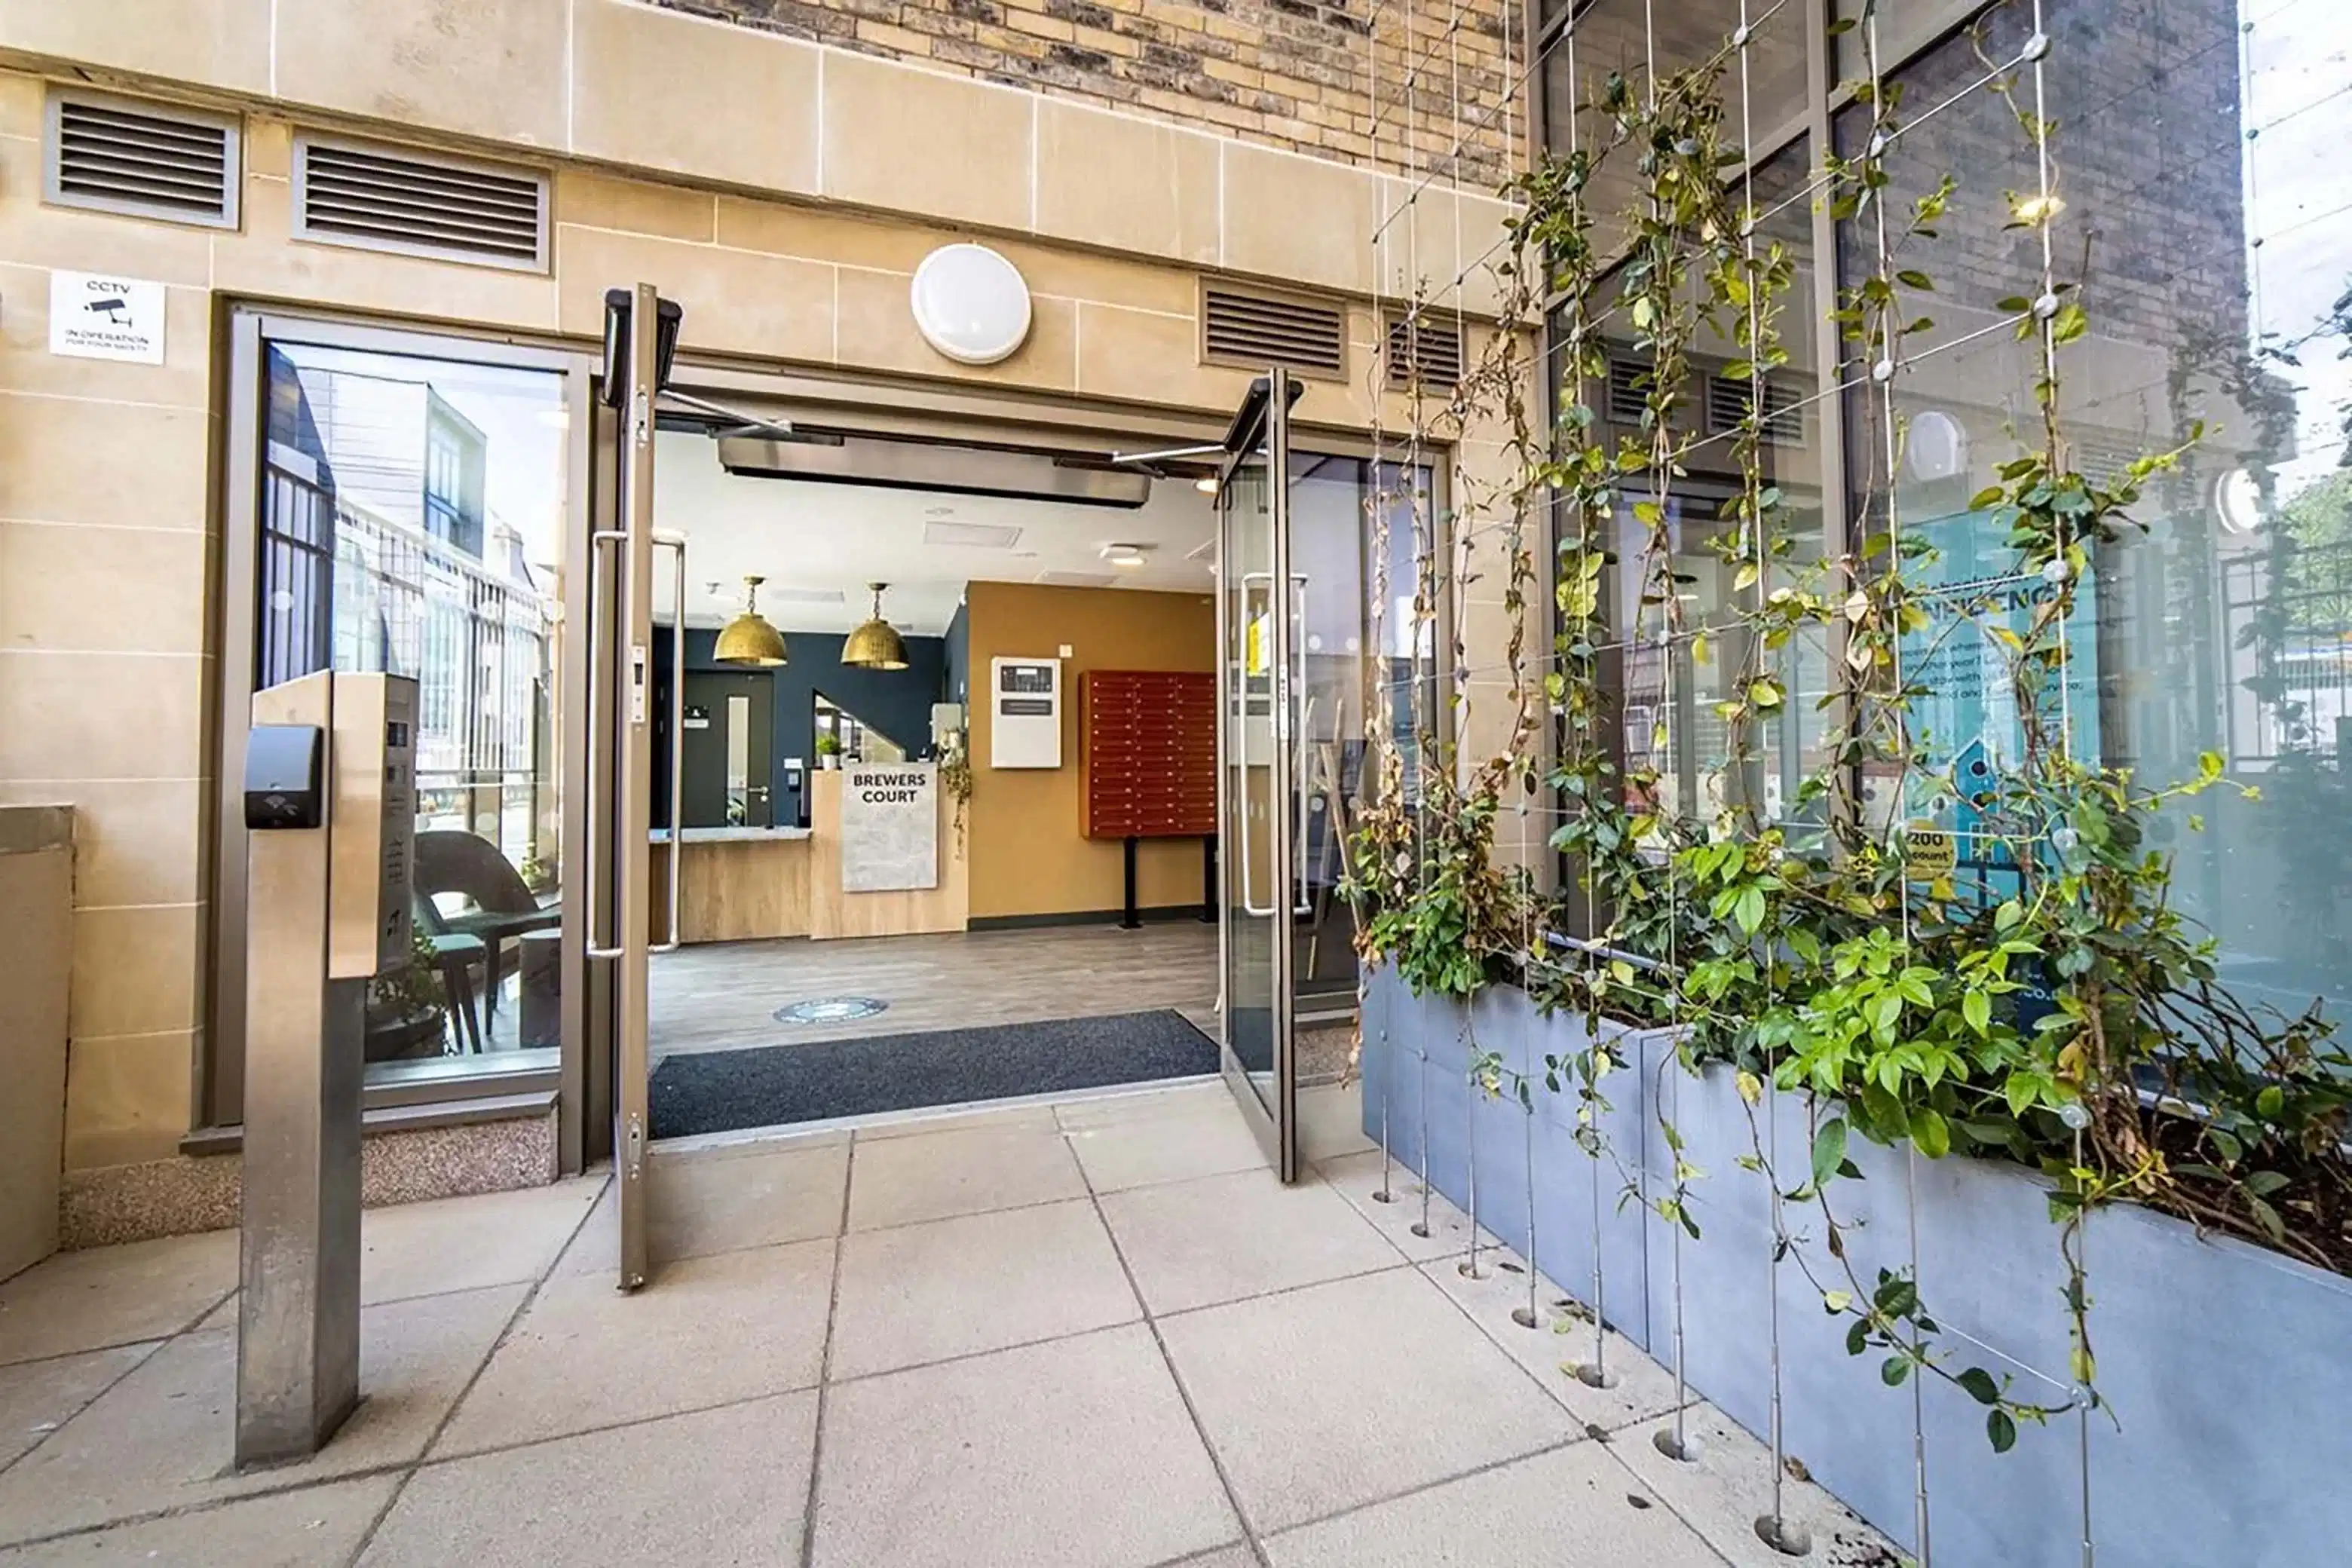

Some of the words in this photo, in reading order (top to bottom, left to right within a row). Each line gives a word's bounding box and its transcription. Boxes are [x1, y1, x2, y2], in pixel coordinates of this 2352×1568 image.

[86, 280, 131, 295] CCTV
[853, 773, 926, 787] BREWERS
[862, 790, 917, 804] COURT
